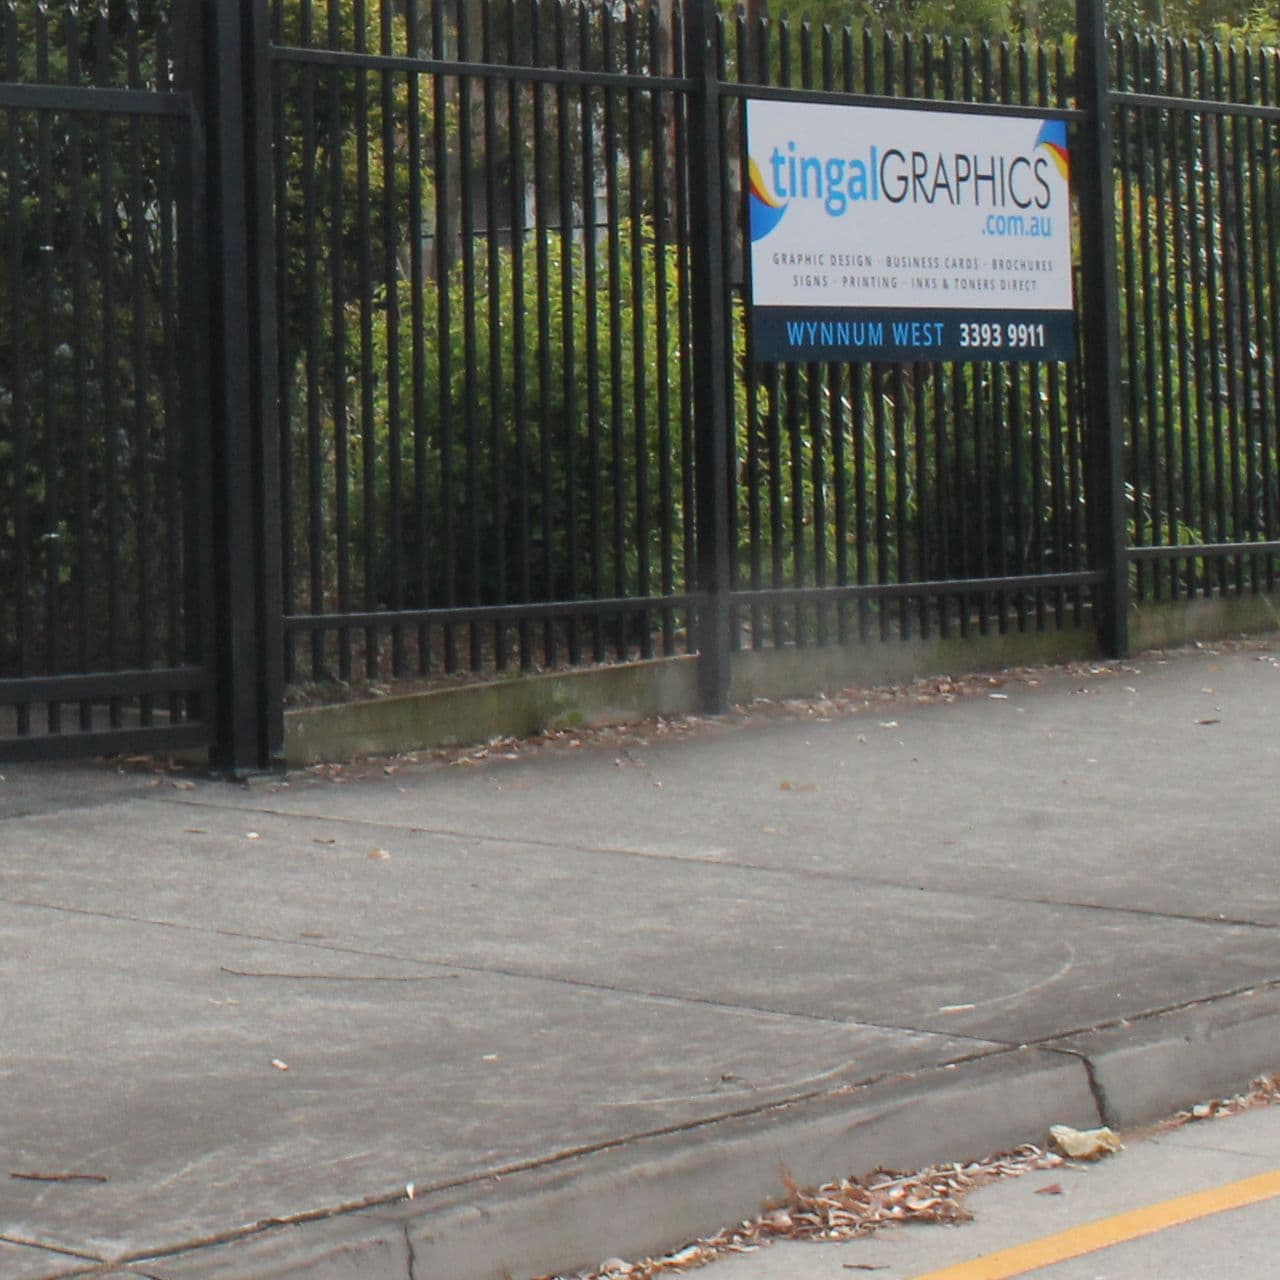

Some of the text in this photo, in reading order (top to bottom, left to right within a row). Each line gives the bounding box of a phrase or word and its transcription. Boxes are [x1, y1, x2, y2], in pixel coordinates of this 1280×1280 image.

[770, 140, 1052, 217] tingalGRAPHICS
[982, 215, 1052, 237] .com.au
[772, 252, 1053, 272] GRAPHIC DESIGN BUSINESS CARDS BROCHURES
[793, 275, 828, 287] SIGNS
[842, 276, 898, 289] PRINTING
[911, 277, 937, 289] INKS
[954, 278, 995, 291] TONERS
[1000, 279, 1037, 292] DIRECT
[786, 321, 1045, 347] WYNNUM WEST 3393 9911
